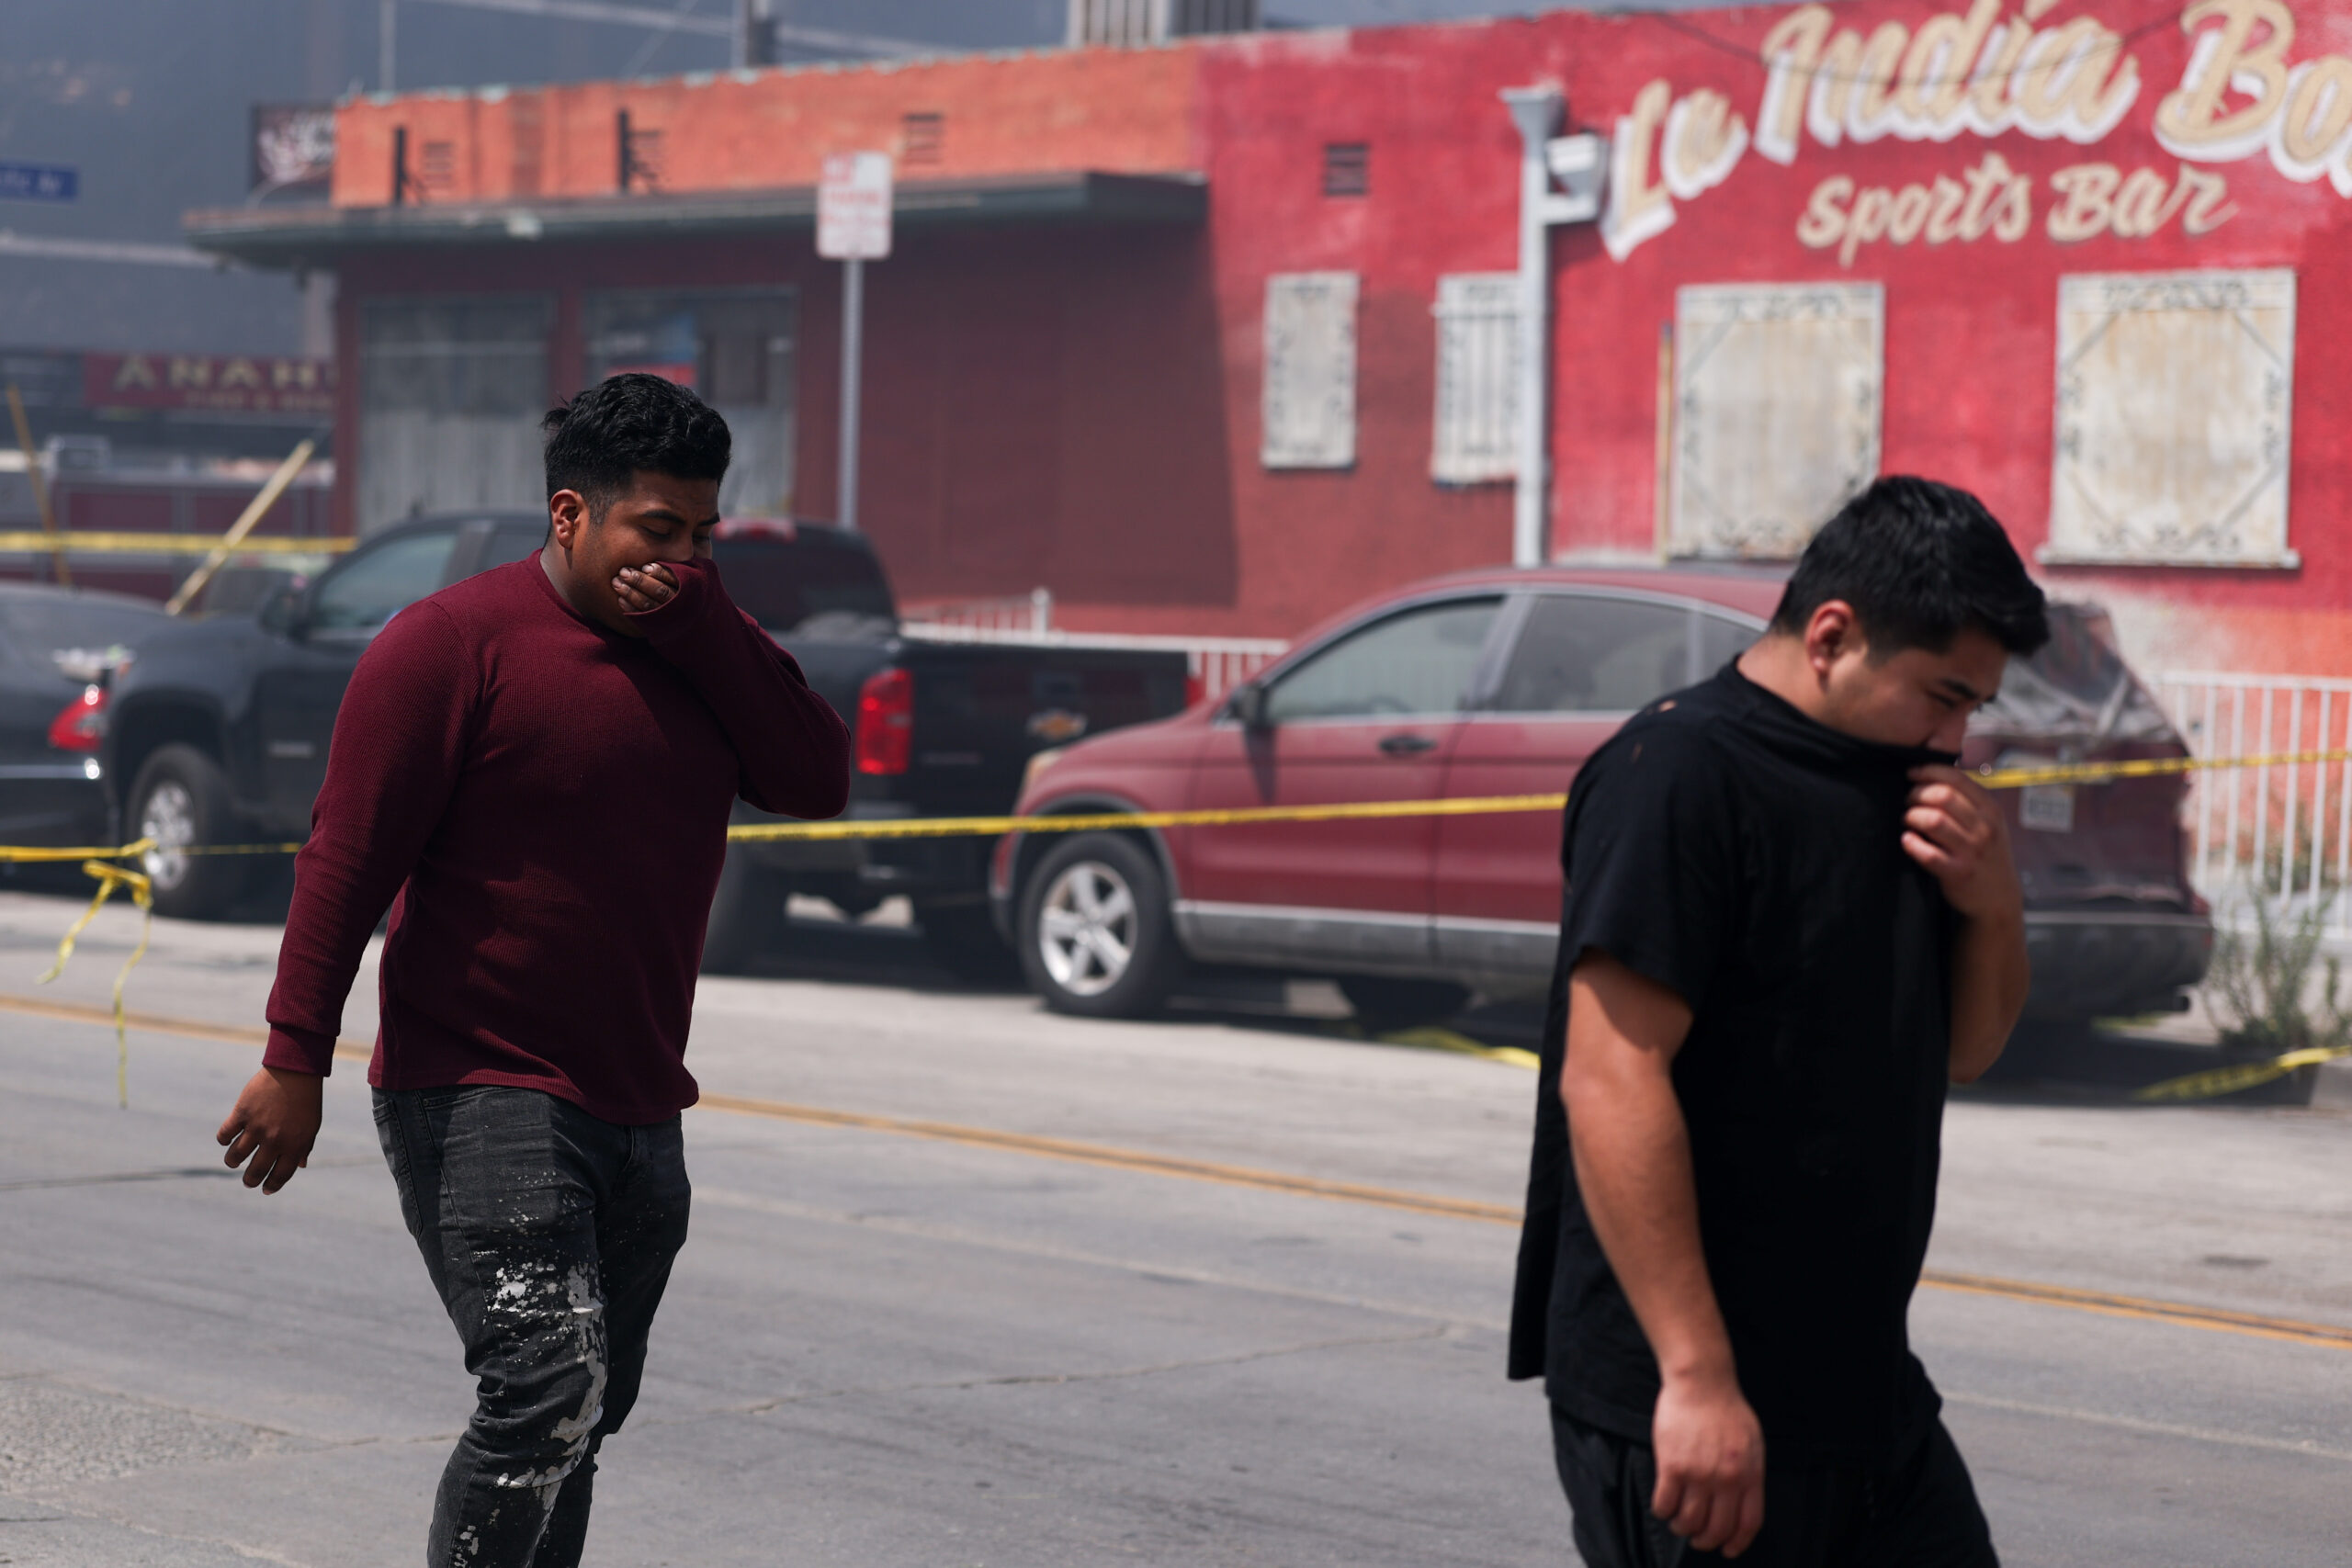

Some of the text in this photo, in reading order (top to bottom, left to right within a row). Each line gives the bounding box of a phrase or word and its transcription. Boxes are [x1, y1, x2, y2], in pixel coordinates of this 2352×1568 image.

[1600, 77, 1748, 263] La
[2153, 0, 2352, 197] Bo
[1795, 152, 2240, 269] Sports Bar
[112, 353, 339, 391] ANAH
